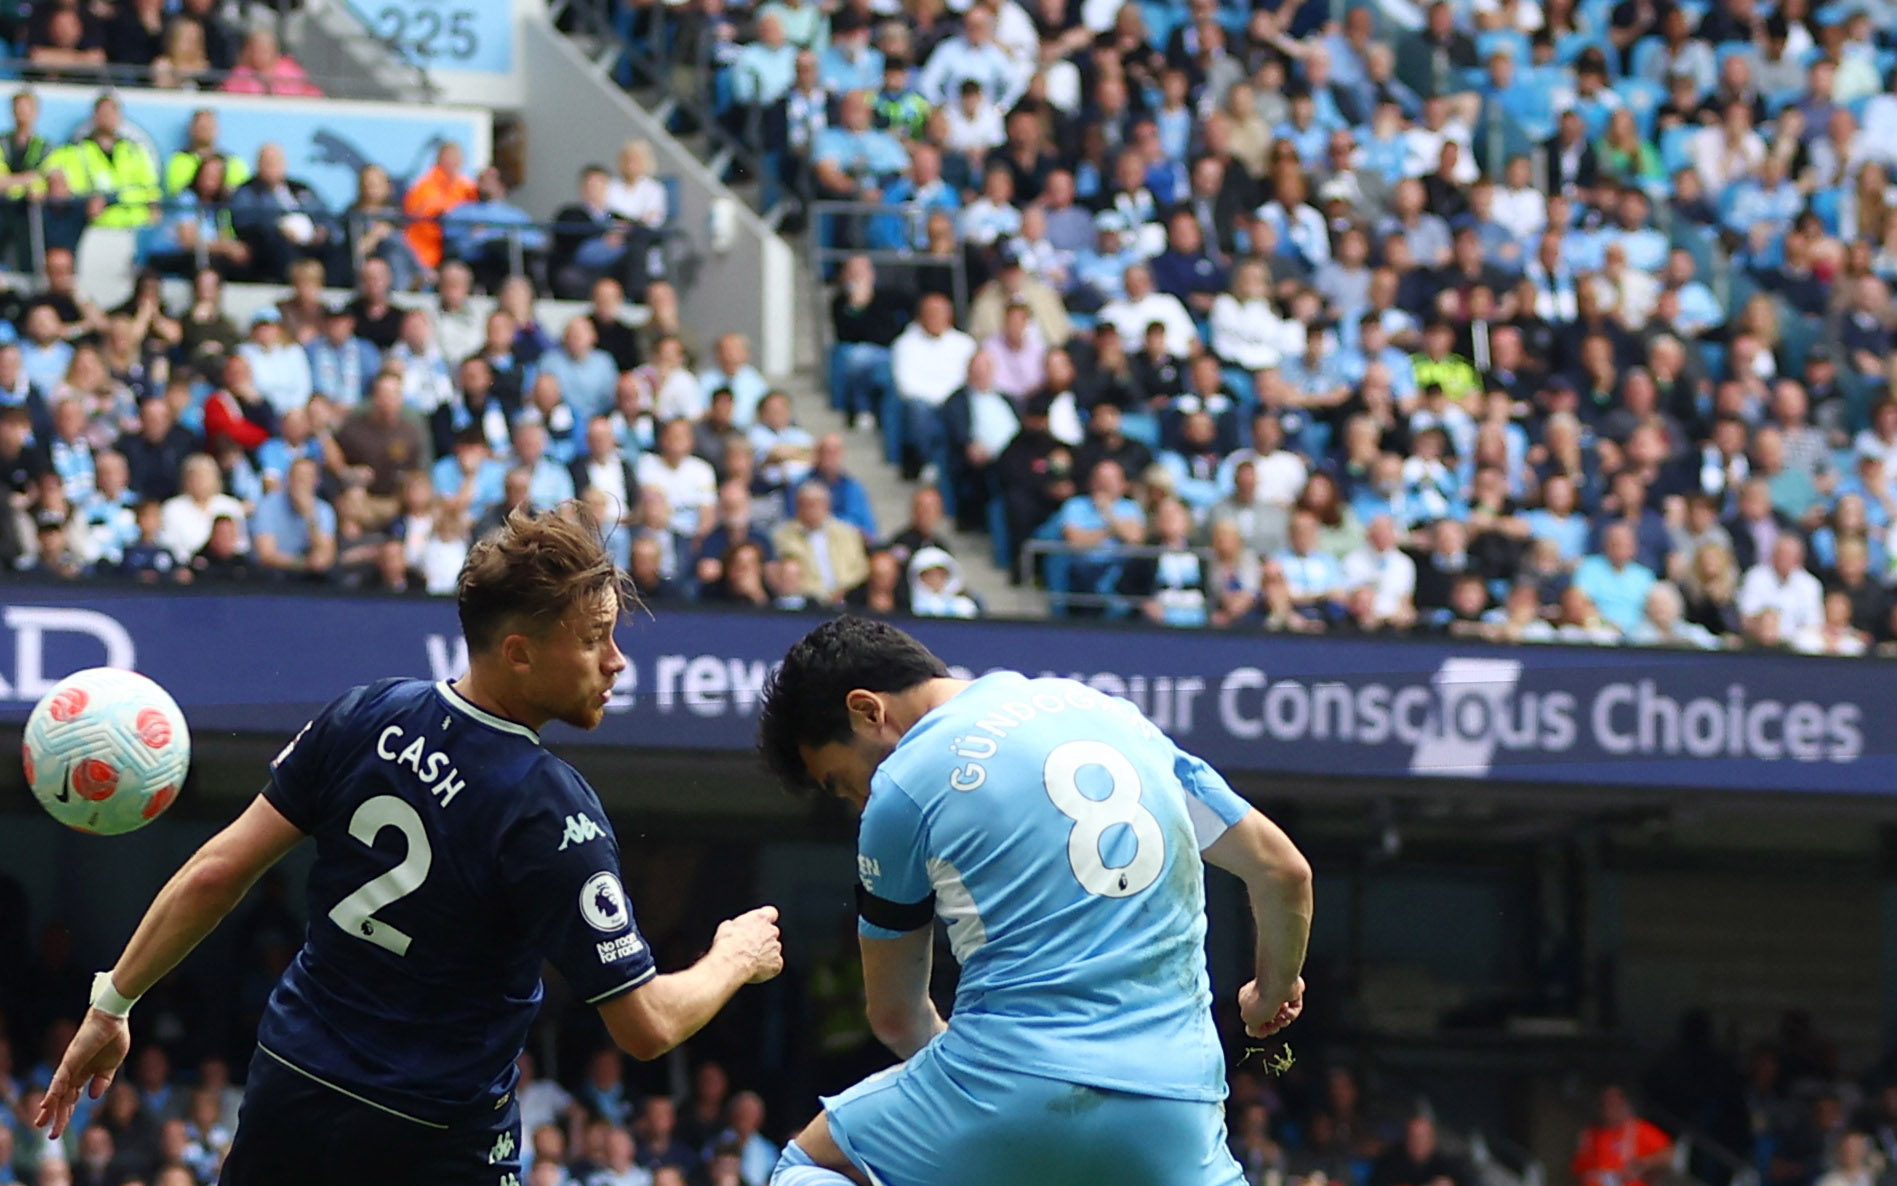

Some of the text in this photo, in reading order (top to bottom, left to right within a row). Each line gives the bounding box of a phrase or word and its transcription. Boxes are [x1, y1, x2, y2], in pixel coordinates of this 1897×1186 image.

[379, 7, 480, 60] 225
[1218, 666, 1578, 752] Conscious
[1591, 677, 1864, 763] Choices
[376, 725, 466, 808] CASH
[1042, 739, 1166, 899] 8
[328, 794, 432, 957] 2
